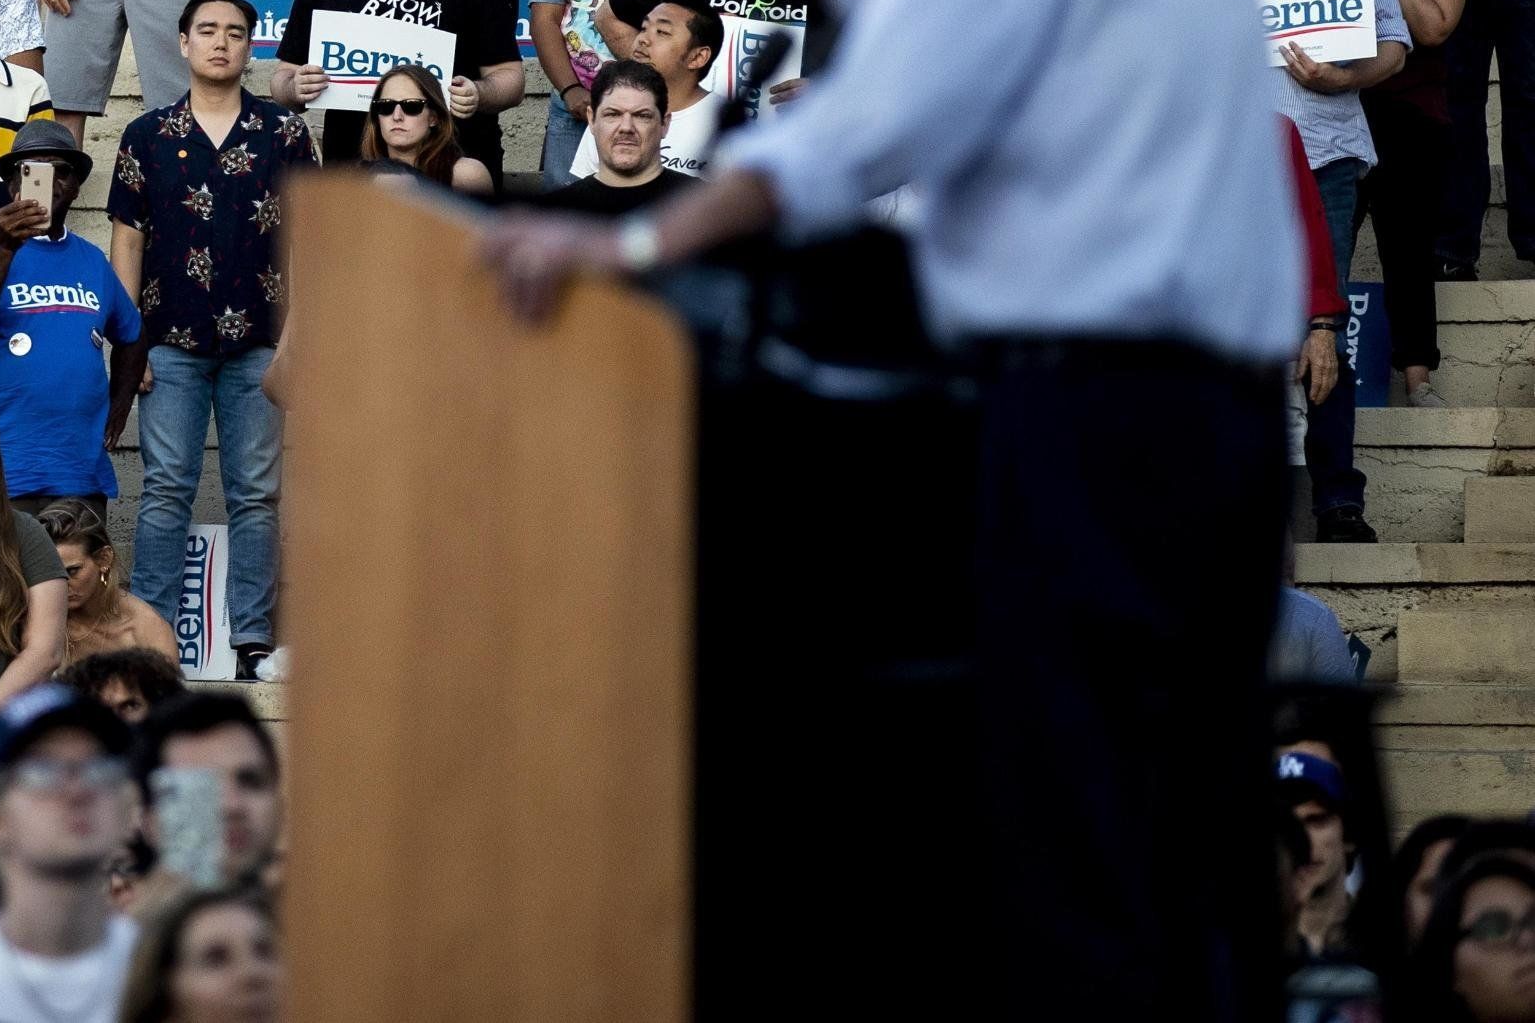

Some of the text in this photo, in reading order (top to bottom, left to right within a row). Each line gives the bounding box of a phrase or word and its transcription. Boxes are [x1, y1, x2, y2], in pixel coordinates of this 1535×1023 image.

[250, 10, 289, 41] nie
[7, 282, 101, 312] Bernie
[177, 534, 208, 669] Bernie
